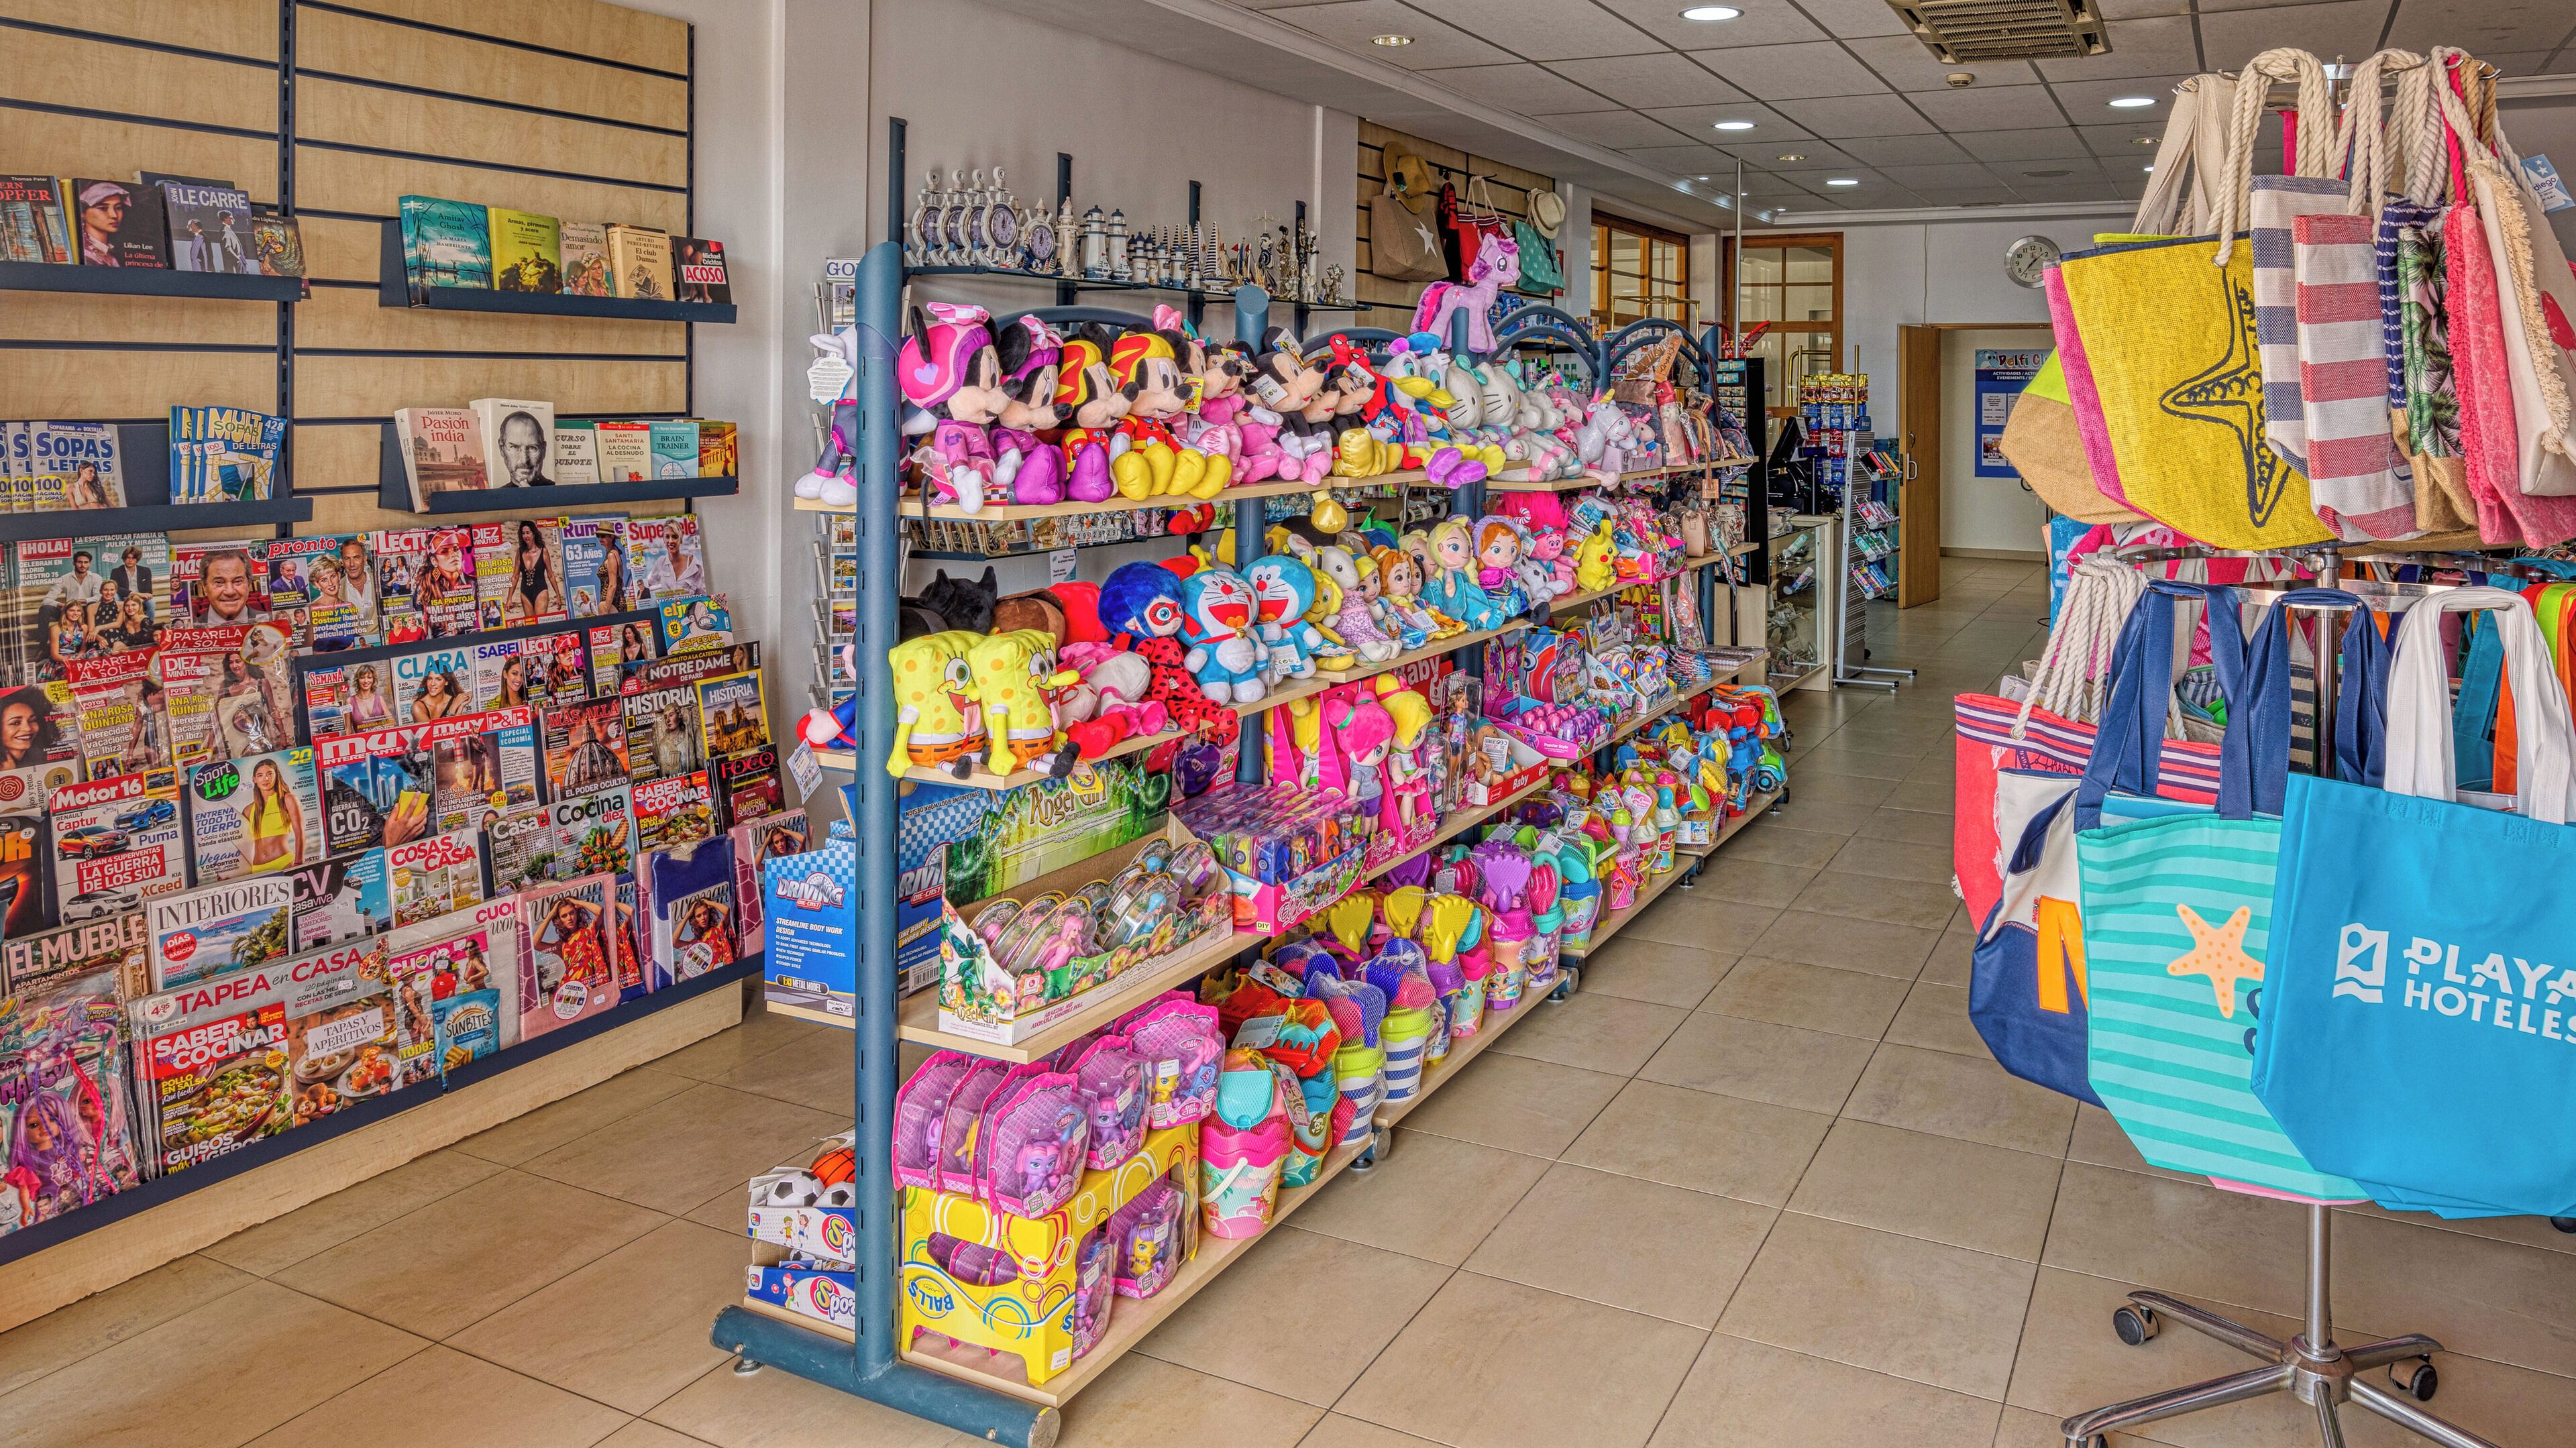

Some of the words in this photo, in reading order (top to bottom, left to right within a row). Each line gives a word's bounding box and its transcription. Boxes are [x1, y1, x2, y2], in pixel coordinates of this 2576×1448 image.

[2534, 178, 2556, 190] diego
[438, 214, 465, 223] Amitav
[439, 221, 465, 231] Ghosh
[562, 232, 602, 245] Demasiado
[566, 242, 585, 250] amor
[636, 256, 657, 264] Dumas
[686, 266, 724, 282] ACOSO
[826, 262, 857, 276] GO
[1998, 353, 2029, 367] Delfi
[2033, 354, 2047, 366] Cl
[265, 420, 284, 431] 428
[421, 416, 470, 429] Pasión
[431, 430, 465, 442] india
[36, 432, 113, 459] SOPAS
[35, 478, 62, 490] 100
[269, 537, 337, 559] pronto
[566, 545, 582, 561] 63
[313, 616, 341, 625] Costner
[430, 614, 453, 623] tiene
[456, 611, 476, 621] algo
[174, 628, 242, 641] PASARELA
[313, 620, 358, 633] protagonizar
[670, 624, 678, 632] 92
[679, 633, 722, 648] ESPECIAL
[165, 656, 197, 670] DIEZ
[397, 651, 469, 679] CLARA
[650, 659, 694, 680] NOTRE
[696, 654, 731, 669] DAME
[309, 669, 344, 686] SEMANA
[624, 686, 698, 716] HISTORIA
[83, 714, 135, 731] QUINTANA
[433, 718, 485, 734] muy
[488, 709, 530, 729] P&R
[85, 726, 130, 740] merecidas
[87, 734, 133, 748] vacaciones
[323, 726, 431, 759] muy
[722, 752, 775, 779] FOCO
[195, 763, 231, 786] Sport
[1512, 774, 1529, 790] Baby
[56, 788, 117, 809] Motor
[121, 779, 143, 795] 16
[203, 773, 240, 799] Life
[576, 785, 599, 795] PODER
[600, 778, 627, 789] OCULTO
[635, 780, 682, 801] SABER
[449, 794, 486, 805] INFLUENCER
[645, 787, 708, 812] COCINAR
[1028, 786, 1074, 827] Angel
[56, 812, 83, 821] RENAULT
[195, 807, 235, 820] ENTRENA
[557, 794, 625, 826] Cocina
[602, 810, 625, 824] diez
[57, 816, 98, 832] Captur
[197, 820, 241, 836] CUERPO
[139, 830, 178, 846] Puma
[391, 836, 453, 867] COSAS
[455, 831, 467, 848] de
[80, 859, 107, 869] LLEGAN
[114, 847, 160, 860] SUPERVENTAS
[200, 850, 241, 867] Vegano
[83, 867, 102, 881] LA
[104, 854, 160, 875] GUERRA
[84, 879, 102, 893] DE
[105, 873, 132, 887] LOS
[135, 865, 161, 881] SUV
[141, 878, 182, 897] XCeed
[777, 878, 845, 906] DRIVING
[912, 887, 942, 901] DIE-CAST
[158, 882, 290, 930] INTERIORES
[798, 900, 820, 908] DIE-CAST
[1326, 893, 1340, 905] STYLE
[776, 917, 809, 930] STREAMLINE
[826, 926, 843, 935] WORK
[776, 927, 795, 936] DESIGN
[9, 944, 41, 977] EL
[42, 914, 146, 969] MUEBLE
[168, 933, 191, 947] DÍAS
[2403, 936, 2576, 1005] PLAYA
[176, 974, 271, 1015] TAPEA
[272, 971, 290, 985] en
[292, 948, 362, 982] CASA
[783, 977, 792, 987] 1:43
[792, 979, 806, 990] METAL
[807, 982, 822, 993] MODEL
[297, 994, 311, 1002] CON
[313, 990, 325, 998] LAS
[2404, 979, 2576, 1045] HOTELES
[324, 1017, 360, 1036] TAPAS
[361, 1015, 368, 1025] Y
[446, 1010, 493, 1038] SUNBITES
[1031, 1017, 1053, 1029] ADORABLE
[155, 1020, 240, 1058] SABER
[312, 1022, 382, 1052] APERITIVOS
[174, 1024, 284, 1070] COCINAR
[168, 1132, 233, 1165] GUISOS
[908, 1281, 955, 1312] BALLS
